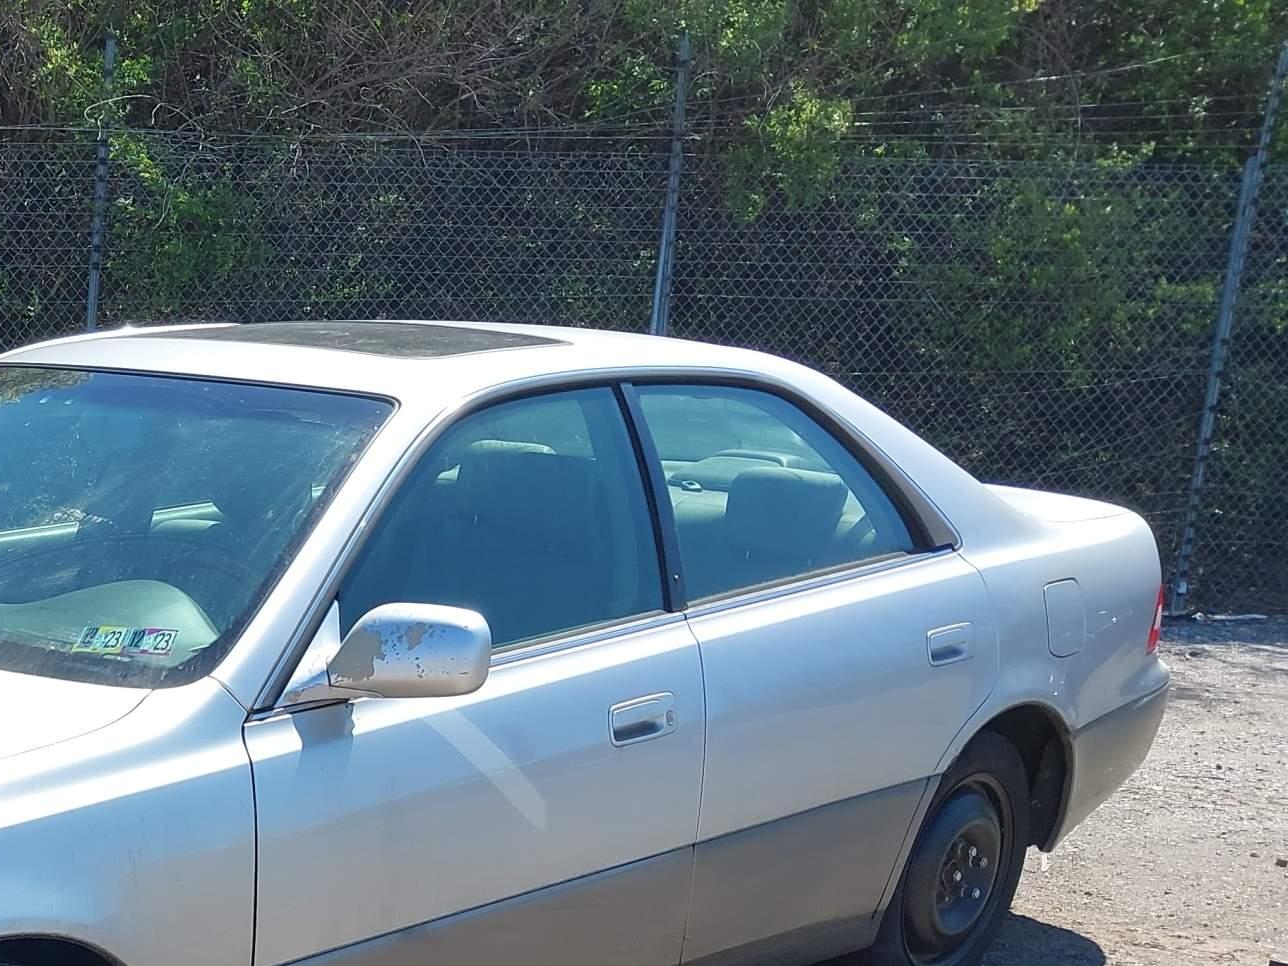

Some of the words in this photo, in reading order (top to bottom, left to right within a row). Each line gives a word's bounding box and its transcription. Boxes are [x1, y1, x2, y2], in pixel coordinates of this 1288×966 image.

[104, 630, 123, 649] 23
[128, 629, 146, 648] 12
[153, 632, 173, 652] 23
